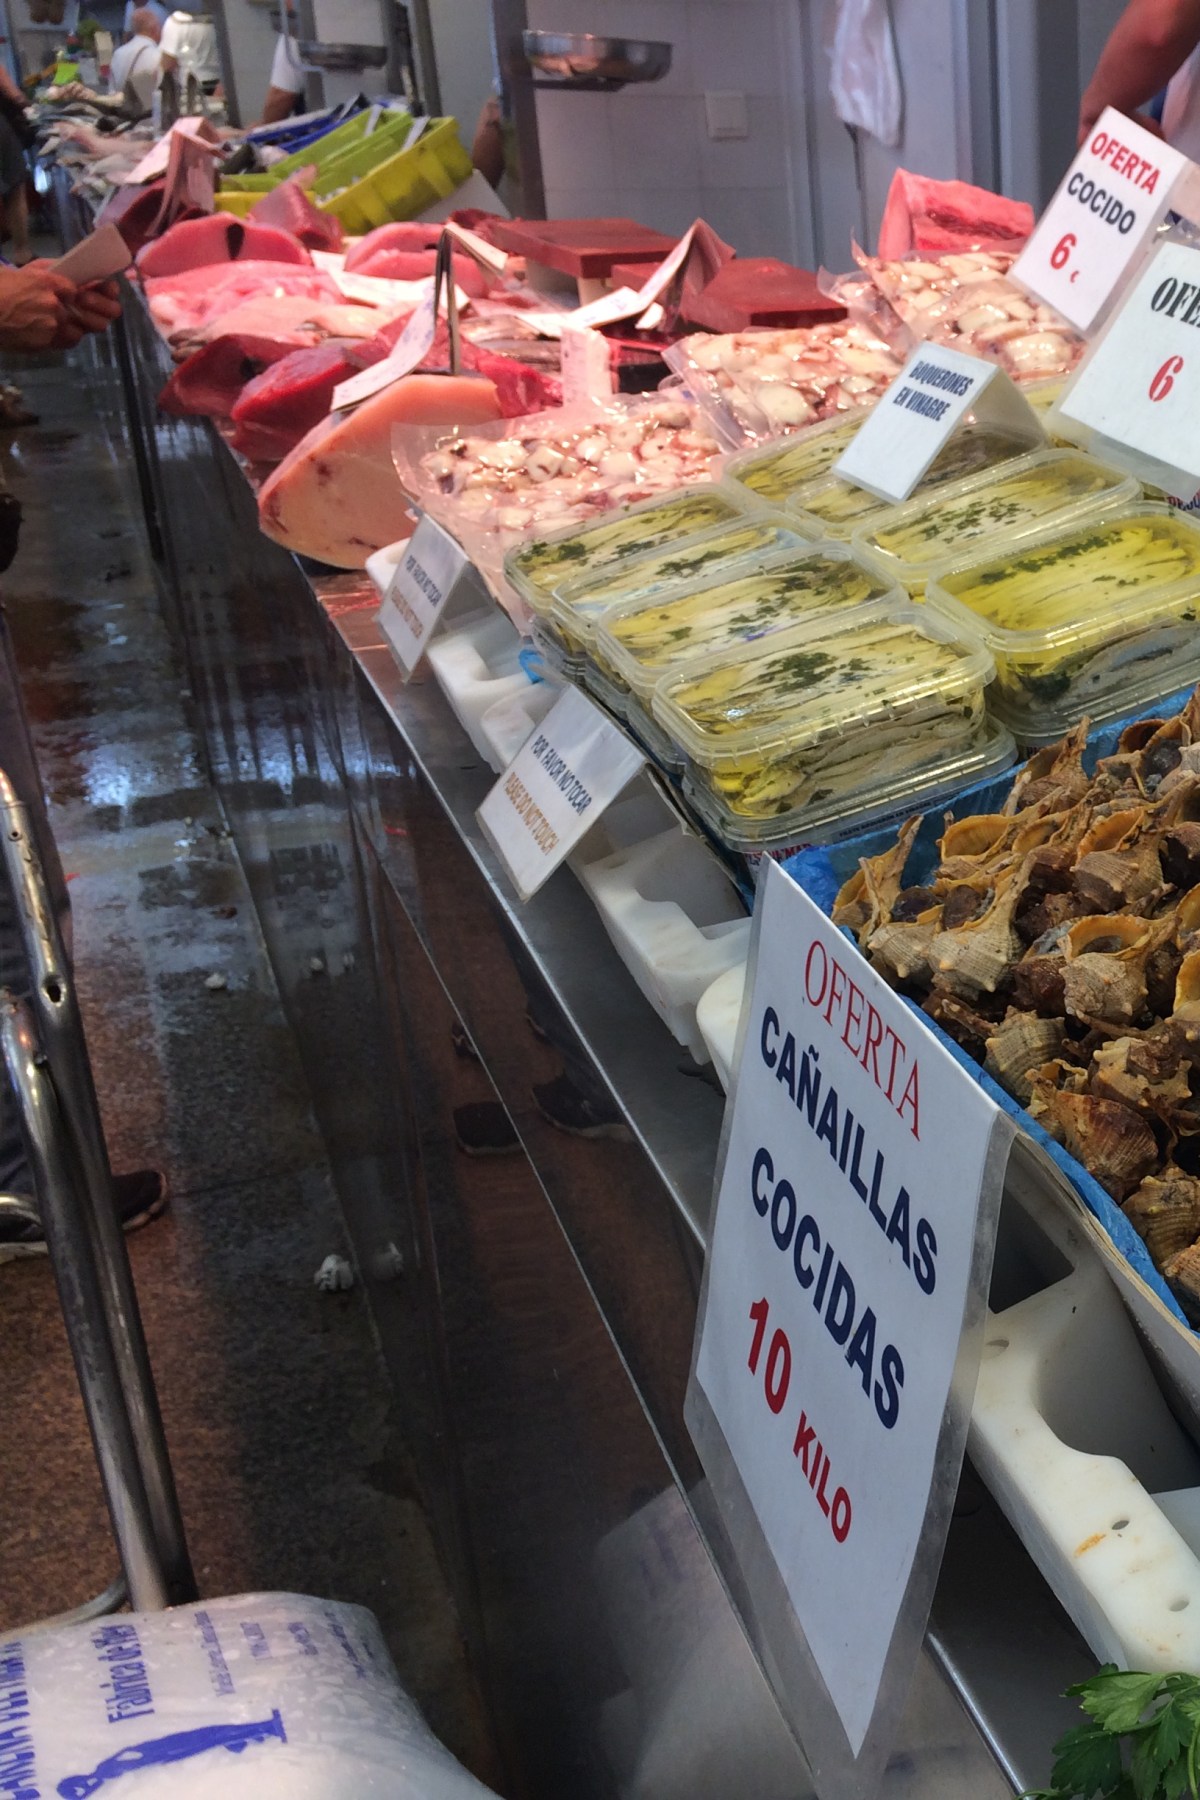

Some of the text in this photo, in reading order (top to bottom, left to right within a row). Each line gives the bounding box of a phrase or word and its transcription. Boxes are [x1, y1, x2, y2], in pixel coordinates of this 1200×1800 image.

[1090, 132, 1161, 195] OFERTA
[1067, 172, 1136, 234] COCIDO
[1050, 232, 1077, 270] 6
[893, 386, 951, 422] EN VINAGRE
[909, 360, 974, 397] BOQUERONES
[1149, 355, 1184, 402] 6
[531, 734, 592, 816] POR FAVOR NO TOCAR
[804, 939, 922, 1142] OFERTA
[760, 1005, 938, 1295] CAÑAILLAS
[751, 1147, 905, 1430] COCIDAS
[748, 1296, 852, 1543] 10 KILO
[100, 1660, 155, 1723] Fábrica
